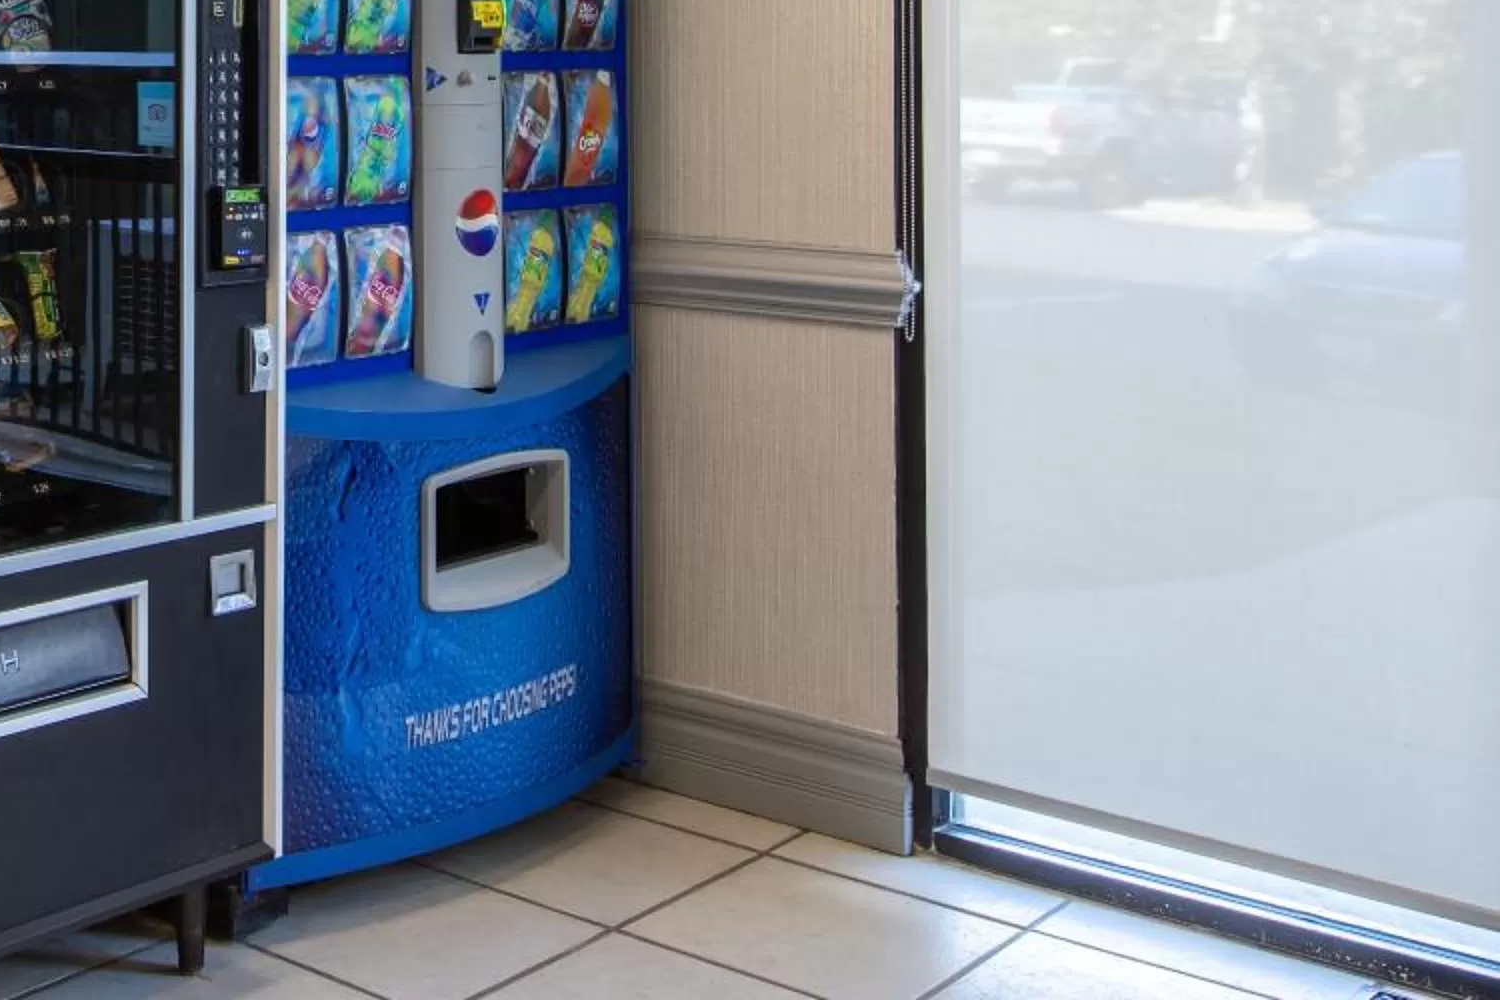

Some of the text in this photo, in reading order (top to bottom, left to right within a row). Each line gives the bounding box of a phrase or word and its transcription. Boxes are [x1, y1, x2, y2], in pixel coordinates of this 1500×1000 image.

[404, 703, 462, 751] THANKS
[462, 695, 490, 738] FOR
[490, 674, 549, 728] CHOOSING
